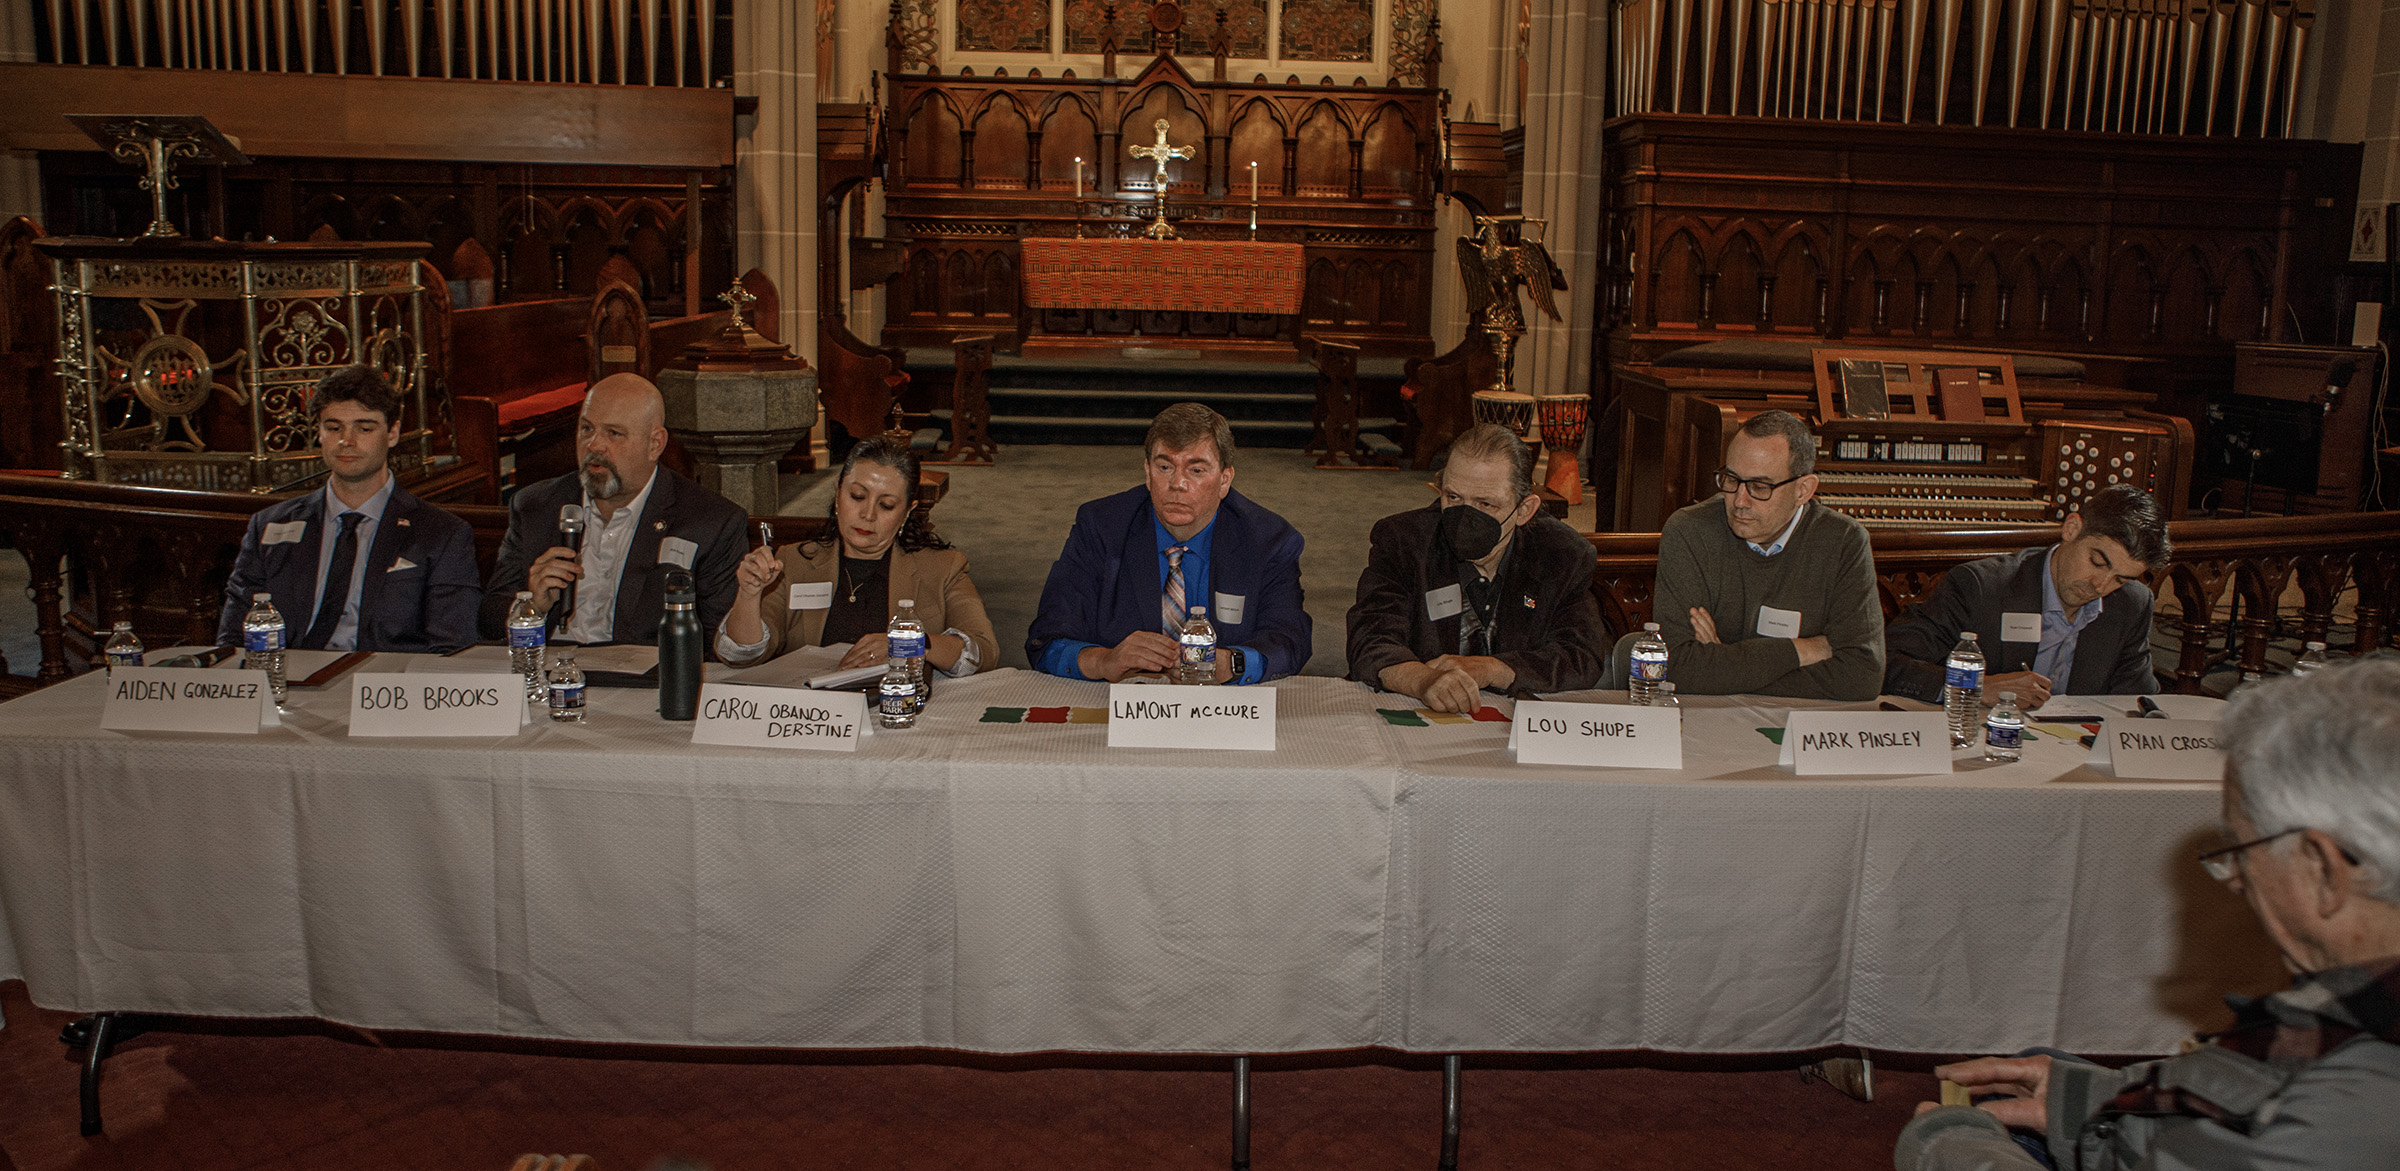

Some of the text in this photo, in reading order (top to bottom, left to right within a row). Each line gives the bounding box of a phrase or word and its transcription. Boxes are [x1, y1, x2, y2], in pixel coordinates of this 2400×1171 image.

[1126, 205, 1195, 217] Serhim
[116, 680, 259, 700] AIDEN GONZALEZ
[361, 686, 499, 710] BOB BROOKS
[704, 697, 762, 720] CAROL
[883, 706, 903, 714] PARK
[1114, 700, 1182, 720] LAMONT
[767, 722, 853, 738] DERSTINE
[1528, 718, 1636, 738] LOU SHUPE
[1802, 730, 1921, 751] MARK PINSLEY
[2119, 732, 2219, 751] RYAN CROSS
